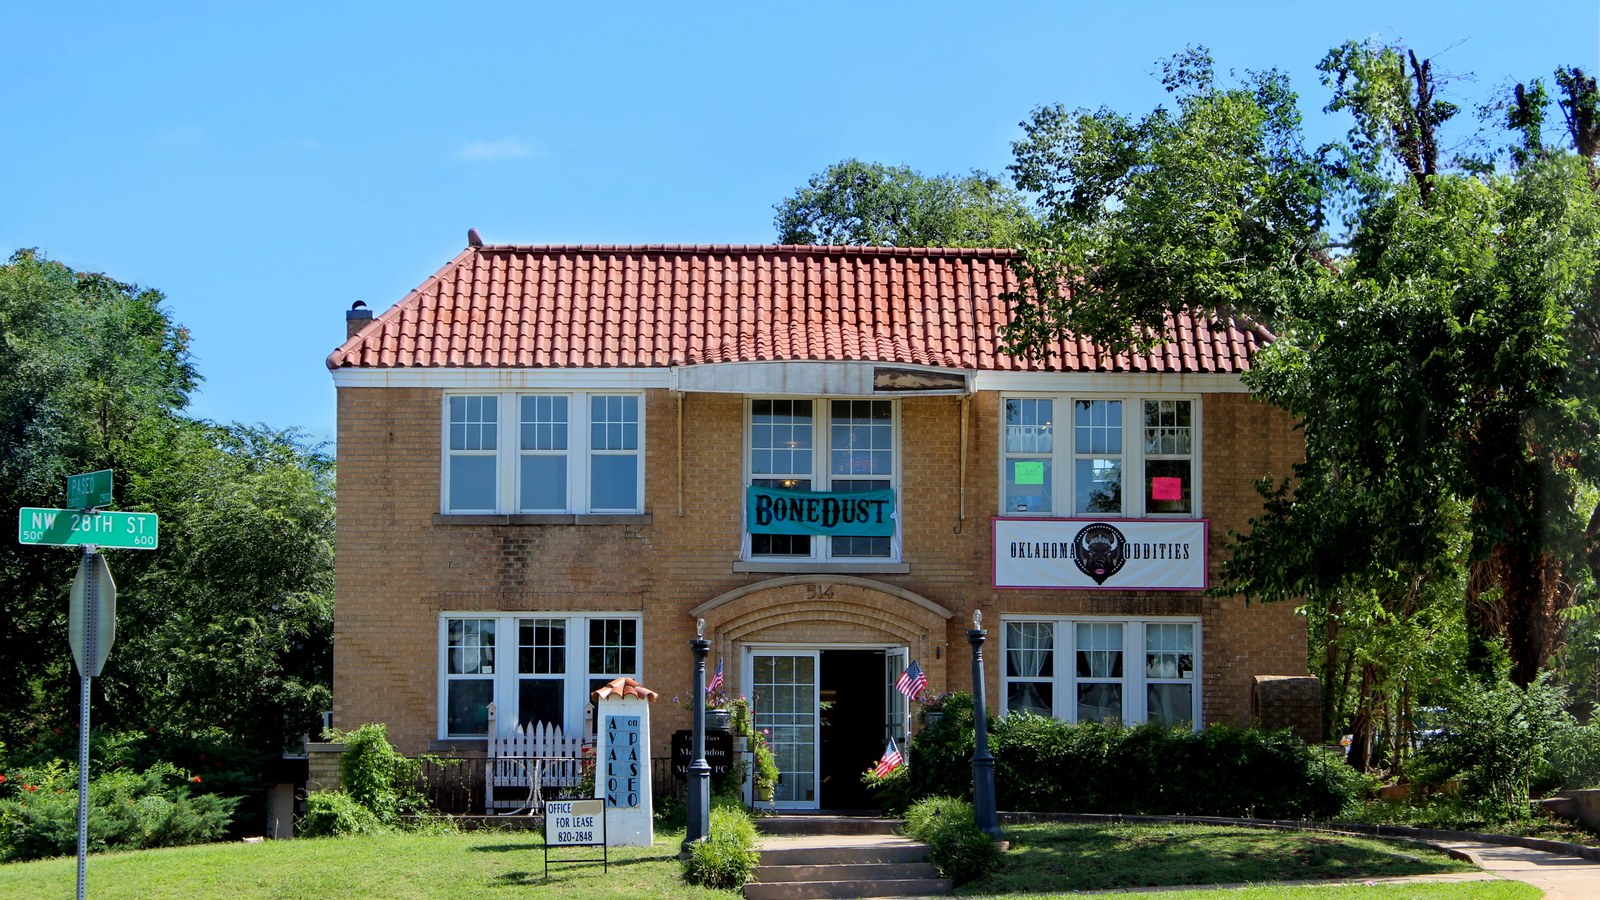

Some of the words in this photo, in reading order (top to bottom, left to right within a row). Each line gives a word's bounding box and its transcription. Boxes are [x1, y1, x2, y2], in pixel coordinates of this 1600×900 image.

[71, 477, 95, 496] PASEO
[32, 512, 56, 529] NW
[71, 514, 113, 532] 28TH
[126, 516, 146, 533] ST
[23, 530, 44, 540] 500
[134, 536, 154, 545] 600
[1010, 541, 1076, 559] OKLAHOMA
[1123, 542, 1190, 559] ODDITIES
[806, 585, 834, 599] 514
[608, 716, 618, 807] AVALON
[627, 732, 638, 807] PASEO
[715, 765, 728, 774] PC
[548, 803, 571, 814] OFFICE
[556, 817, 570, 828] FOR
[572, 817, 593, 828] LEASE
[558, 831, 593, 842] 820-2848
